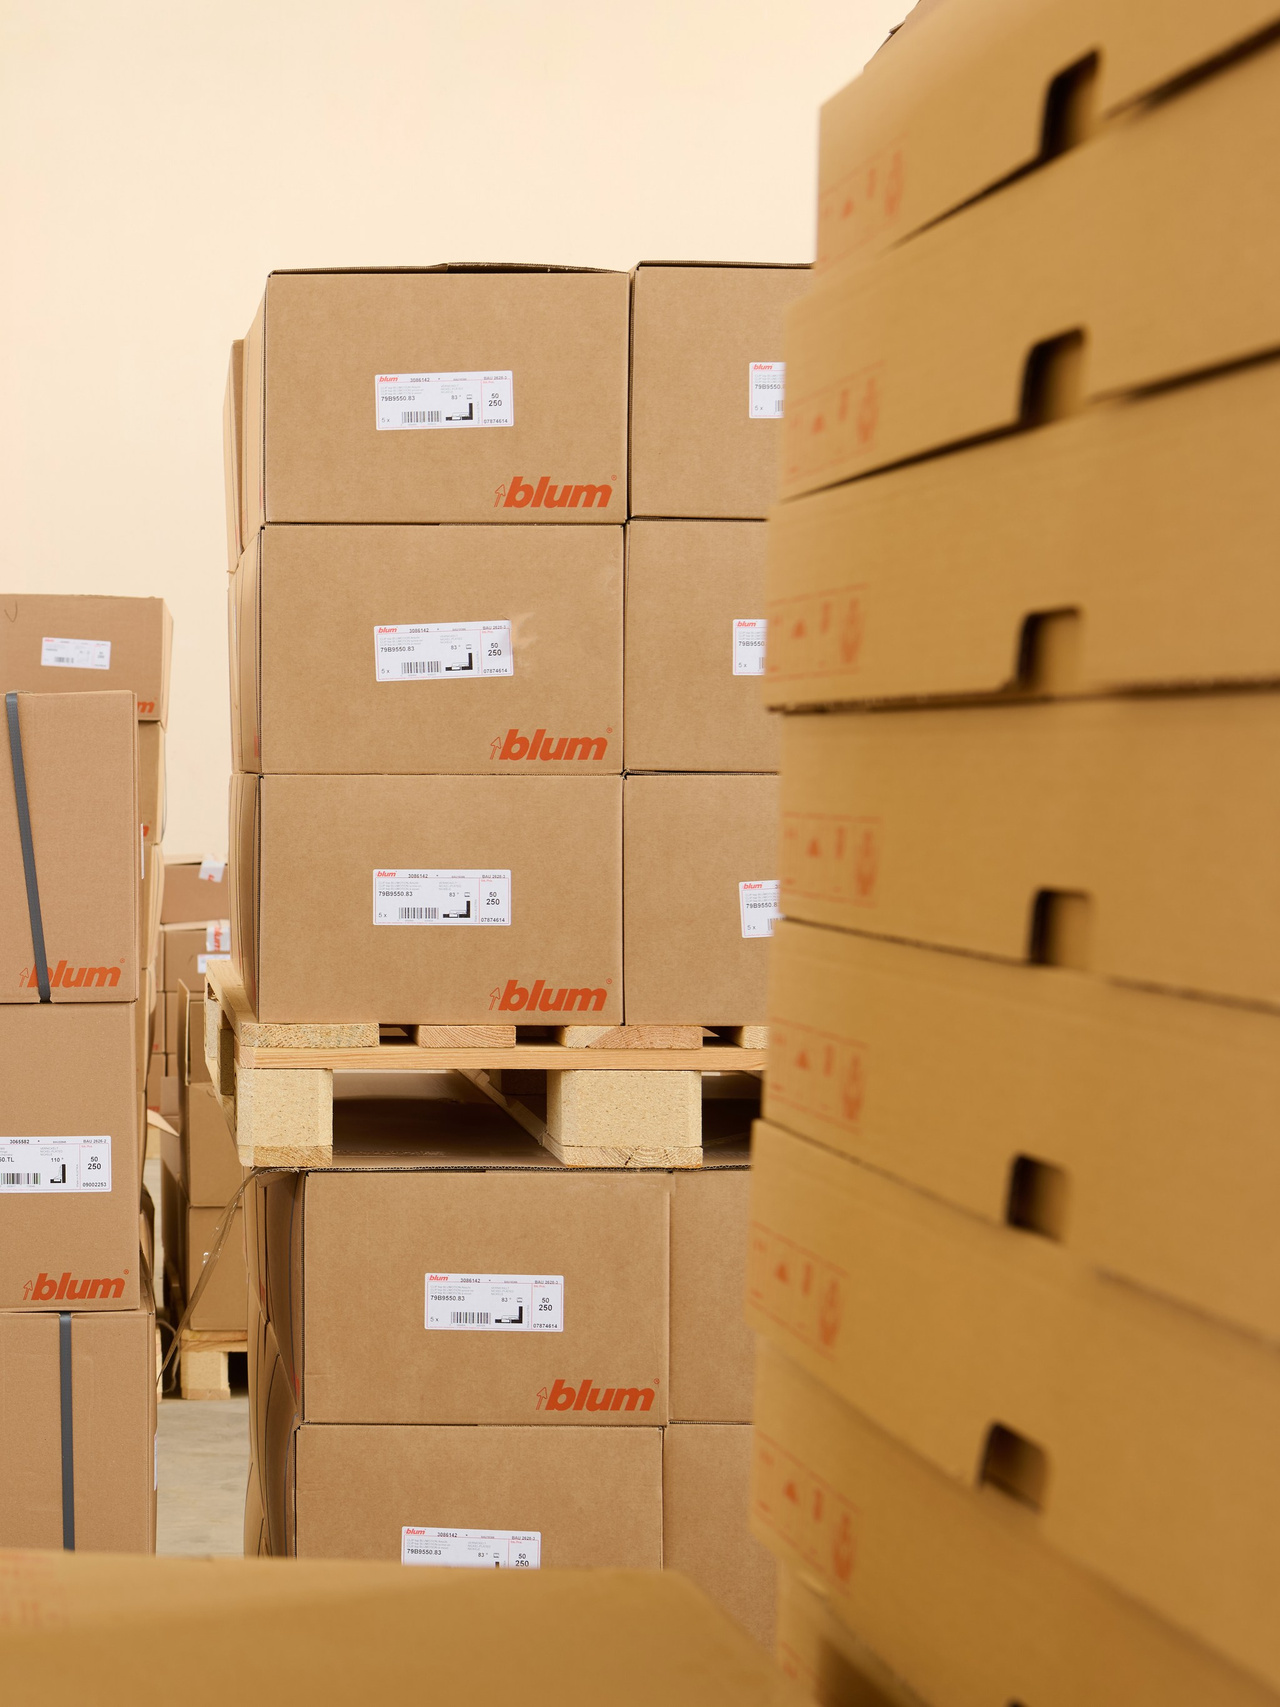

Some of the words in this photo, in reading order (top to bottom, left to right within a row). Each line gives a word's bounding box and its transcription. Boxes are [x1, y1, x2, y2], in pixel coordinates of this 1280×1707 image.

[488, 399, 503, 407] 250
[504, 476, 613, 509] blum
[487, 649, 502, 657] 250
[499, 729, 608, 762] blum
[486, 898, 500, 906] 250
[499, 980, 608, 1012] blum
[32, 1273, 126, 1301] blum
[546, 1380, 655, 1412] blum
